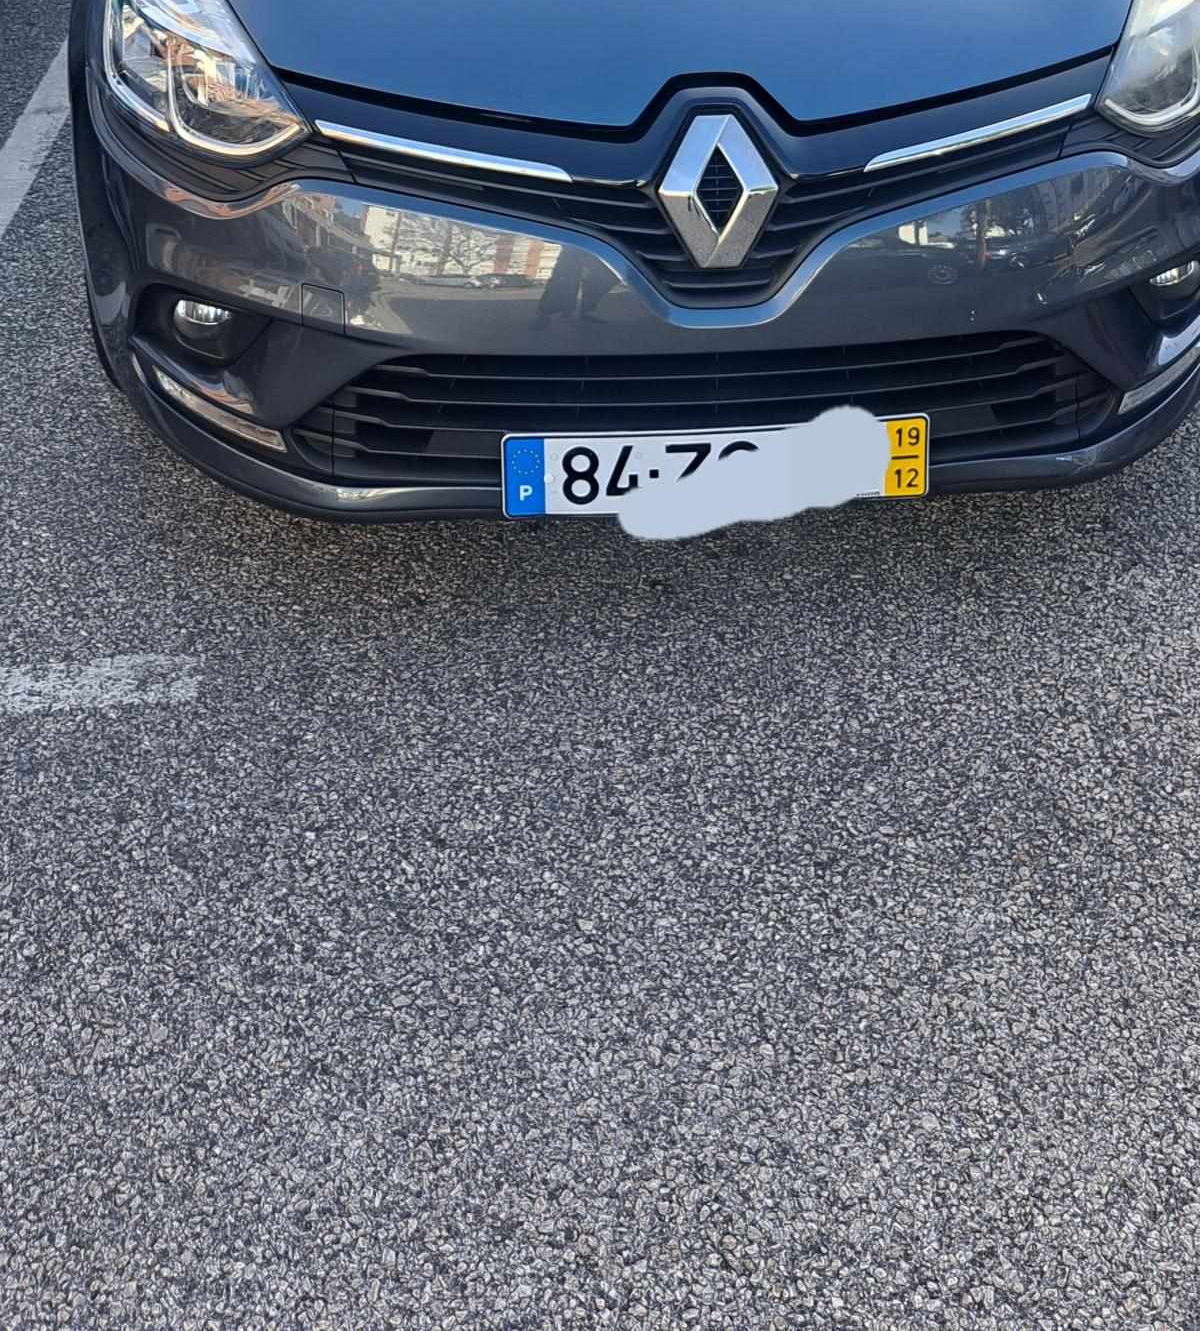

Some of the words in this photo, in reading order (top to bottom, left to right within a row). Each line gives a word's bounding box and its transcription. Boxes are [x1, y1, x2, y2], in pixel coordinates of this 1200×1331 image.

[896, 427, 920, 448] 19
[895, 468, 919, 488] 12
[519, 485, 533, 501] P
